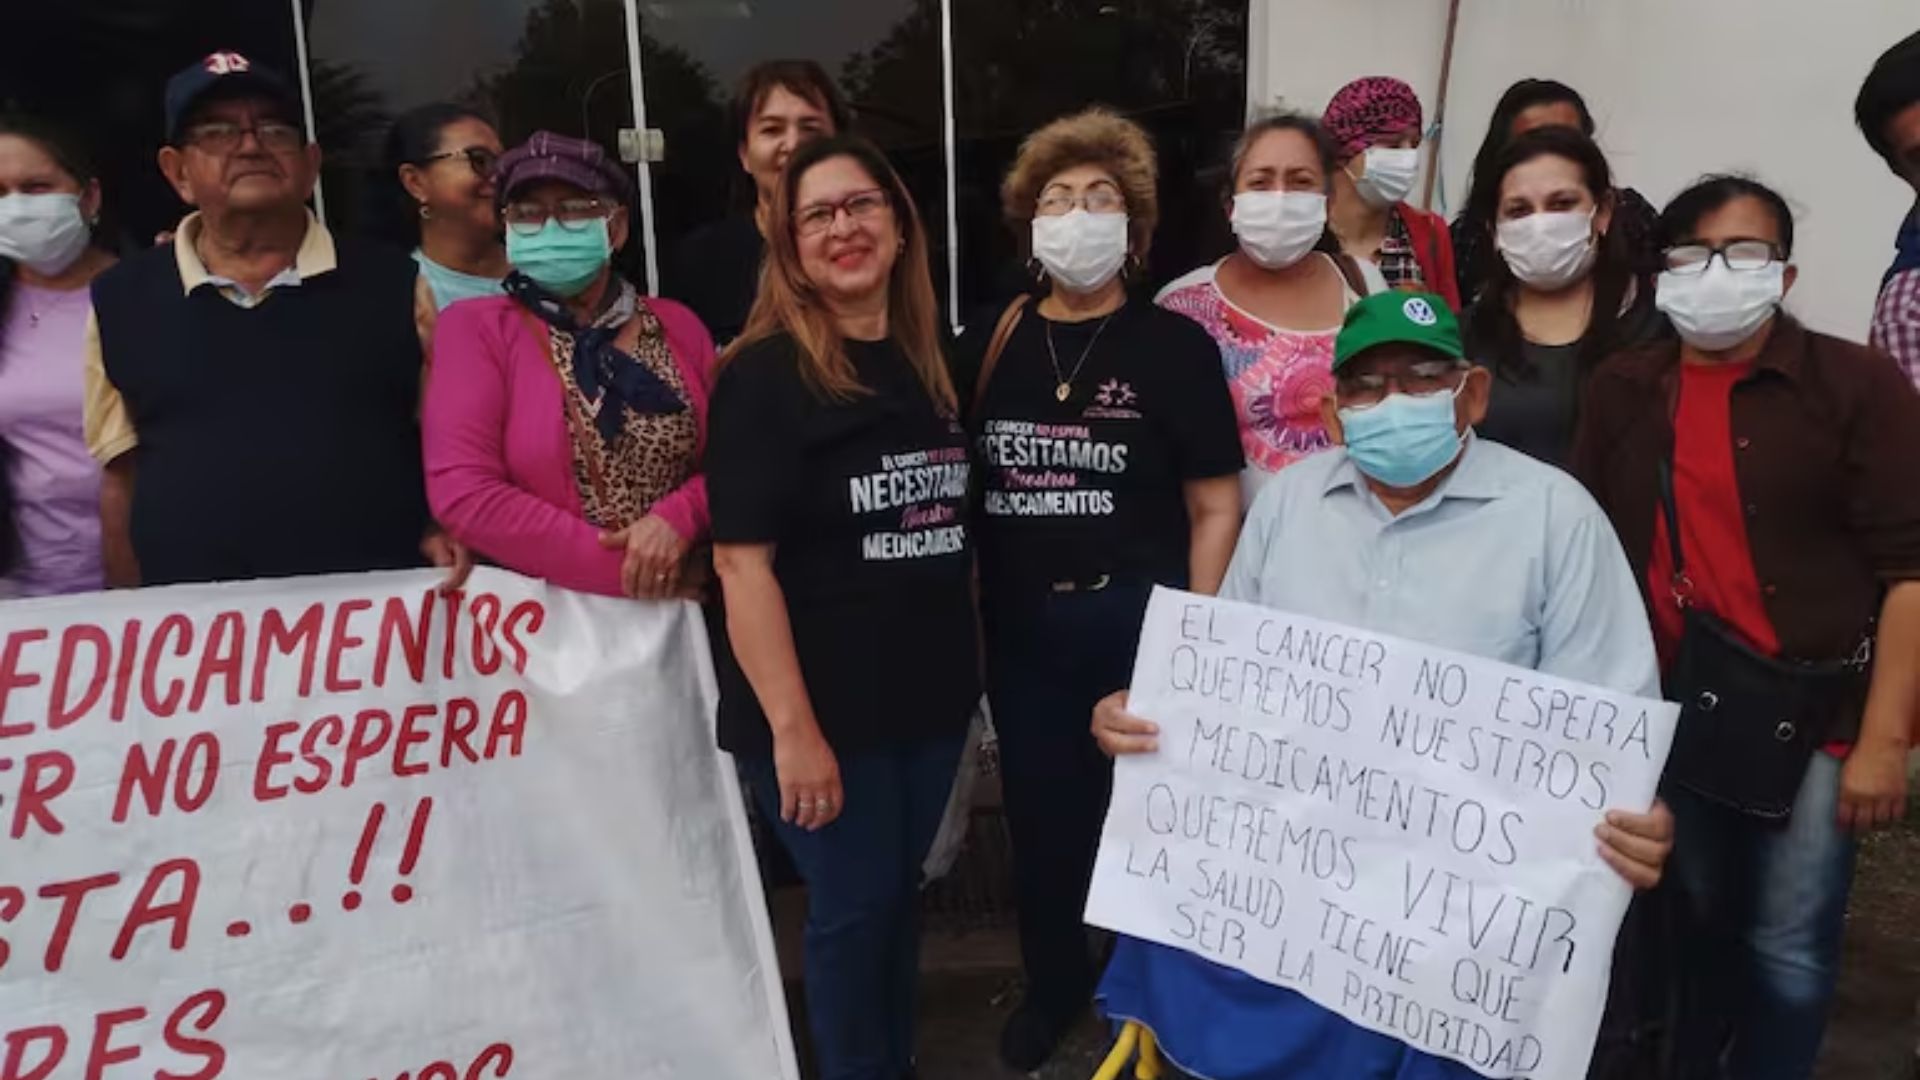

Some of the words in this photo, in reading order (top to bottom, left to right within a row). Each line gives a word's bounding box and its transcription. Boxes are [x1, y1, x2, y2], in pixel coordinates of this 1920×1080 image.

[111, 731, 220, 824] NO
[254, 690, 528, 801] ESPERA
[1171, 644, 1352, 733] QUEREMOS
[1380, 704, 1611, 810] NUESTROS
[1181, 604, 1226, 645] EL
[1256, 619, 1386, 685] CANCER
[1413, 658, 1467, 707] NO
[1495, 677, 1650, 759] ESPERA
[1189, 717, 1524, 865] MEDICAMENTOS
[1126, 843, 1170, 884] LA
[1189, 858, 1285, 929] SALUD
[1318, 898, 1427, 984] TIENE
[1451, 958, 1524, 1024] QUE
[1146, 783, 1357, 891] QUEREMOS
[1405, 860, 1576, 974] VIVIR
[1170, 903, 1245, 960] SER
[1276, 938, 1315, 997] LA
[1342, 969, 1543, 1073] PRIORIDAD
